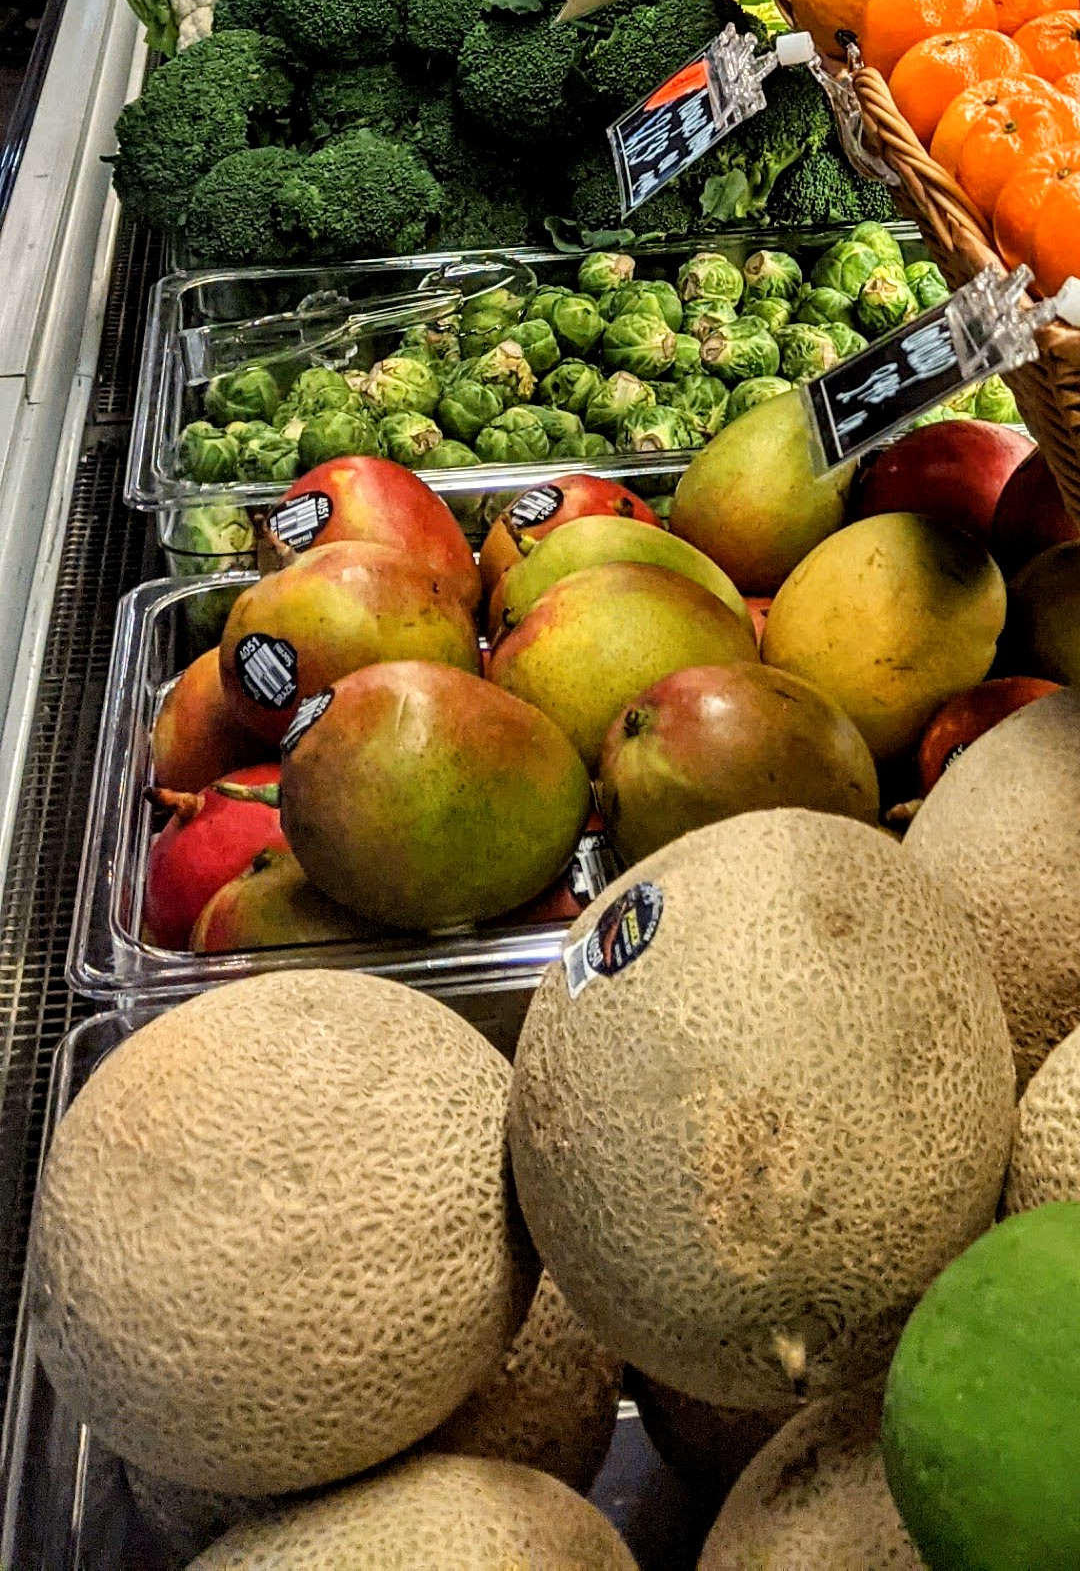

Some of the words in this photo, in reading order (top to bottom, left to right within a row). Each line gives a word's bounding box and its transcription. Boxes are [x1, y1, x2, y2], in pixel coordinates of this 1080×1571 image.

[317, 497, 330, 520] 4051
[239, 636, 260, 661] 4051
[273, 681, 297, 707] BRAZIL
